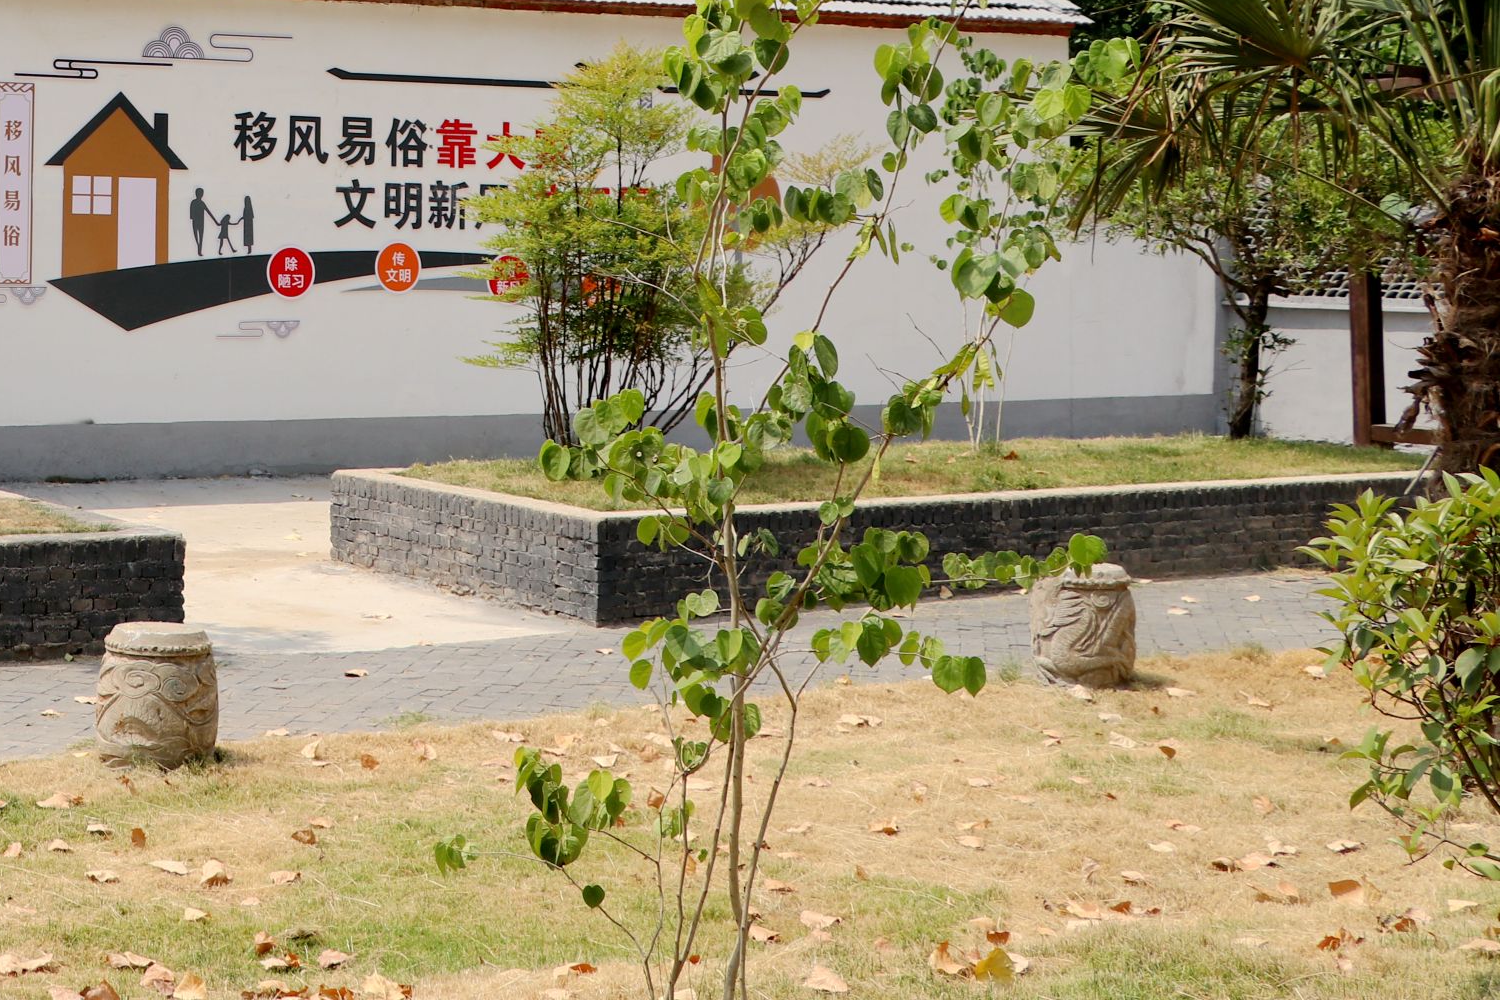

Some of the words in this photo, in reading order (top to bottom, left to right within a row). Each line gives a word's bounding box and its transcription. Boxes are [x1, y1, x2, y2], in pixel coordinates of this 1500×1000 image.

[234, 111, 566, 170] 移风易俗靠大
[3, 119, 23, 248] 移风易俗
[284, 256, 298, 271] 除
[391, 251, 405, 266] 传
[277, 273, 304, 288] 陋习
[385, 268, 411, 283] 文明
